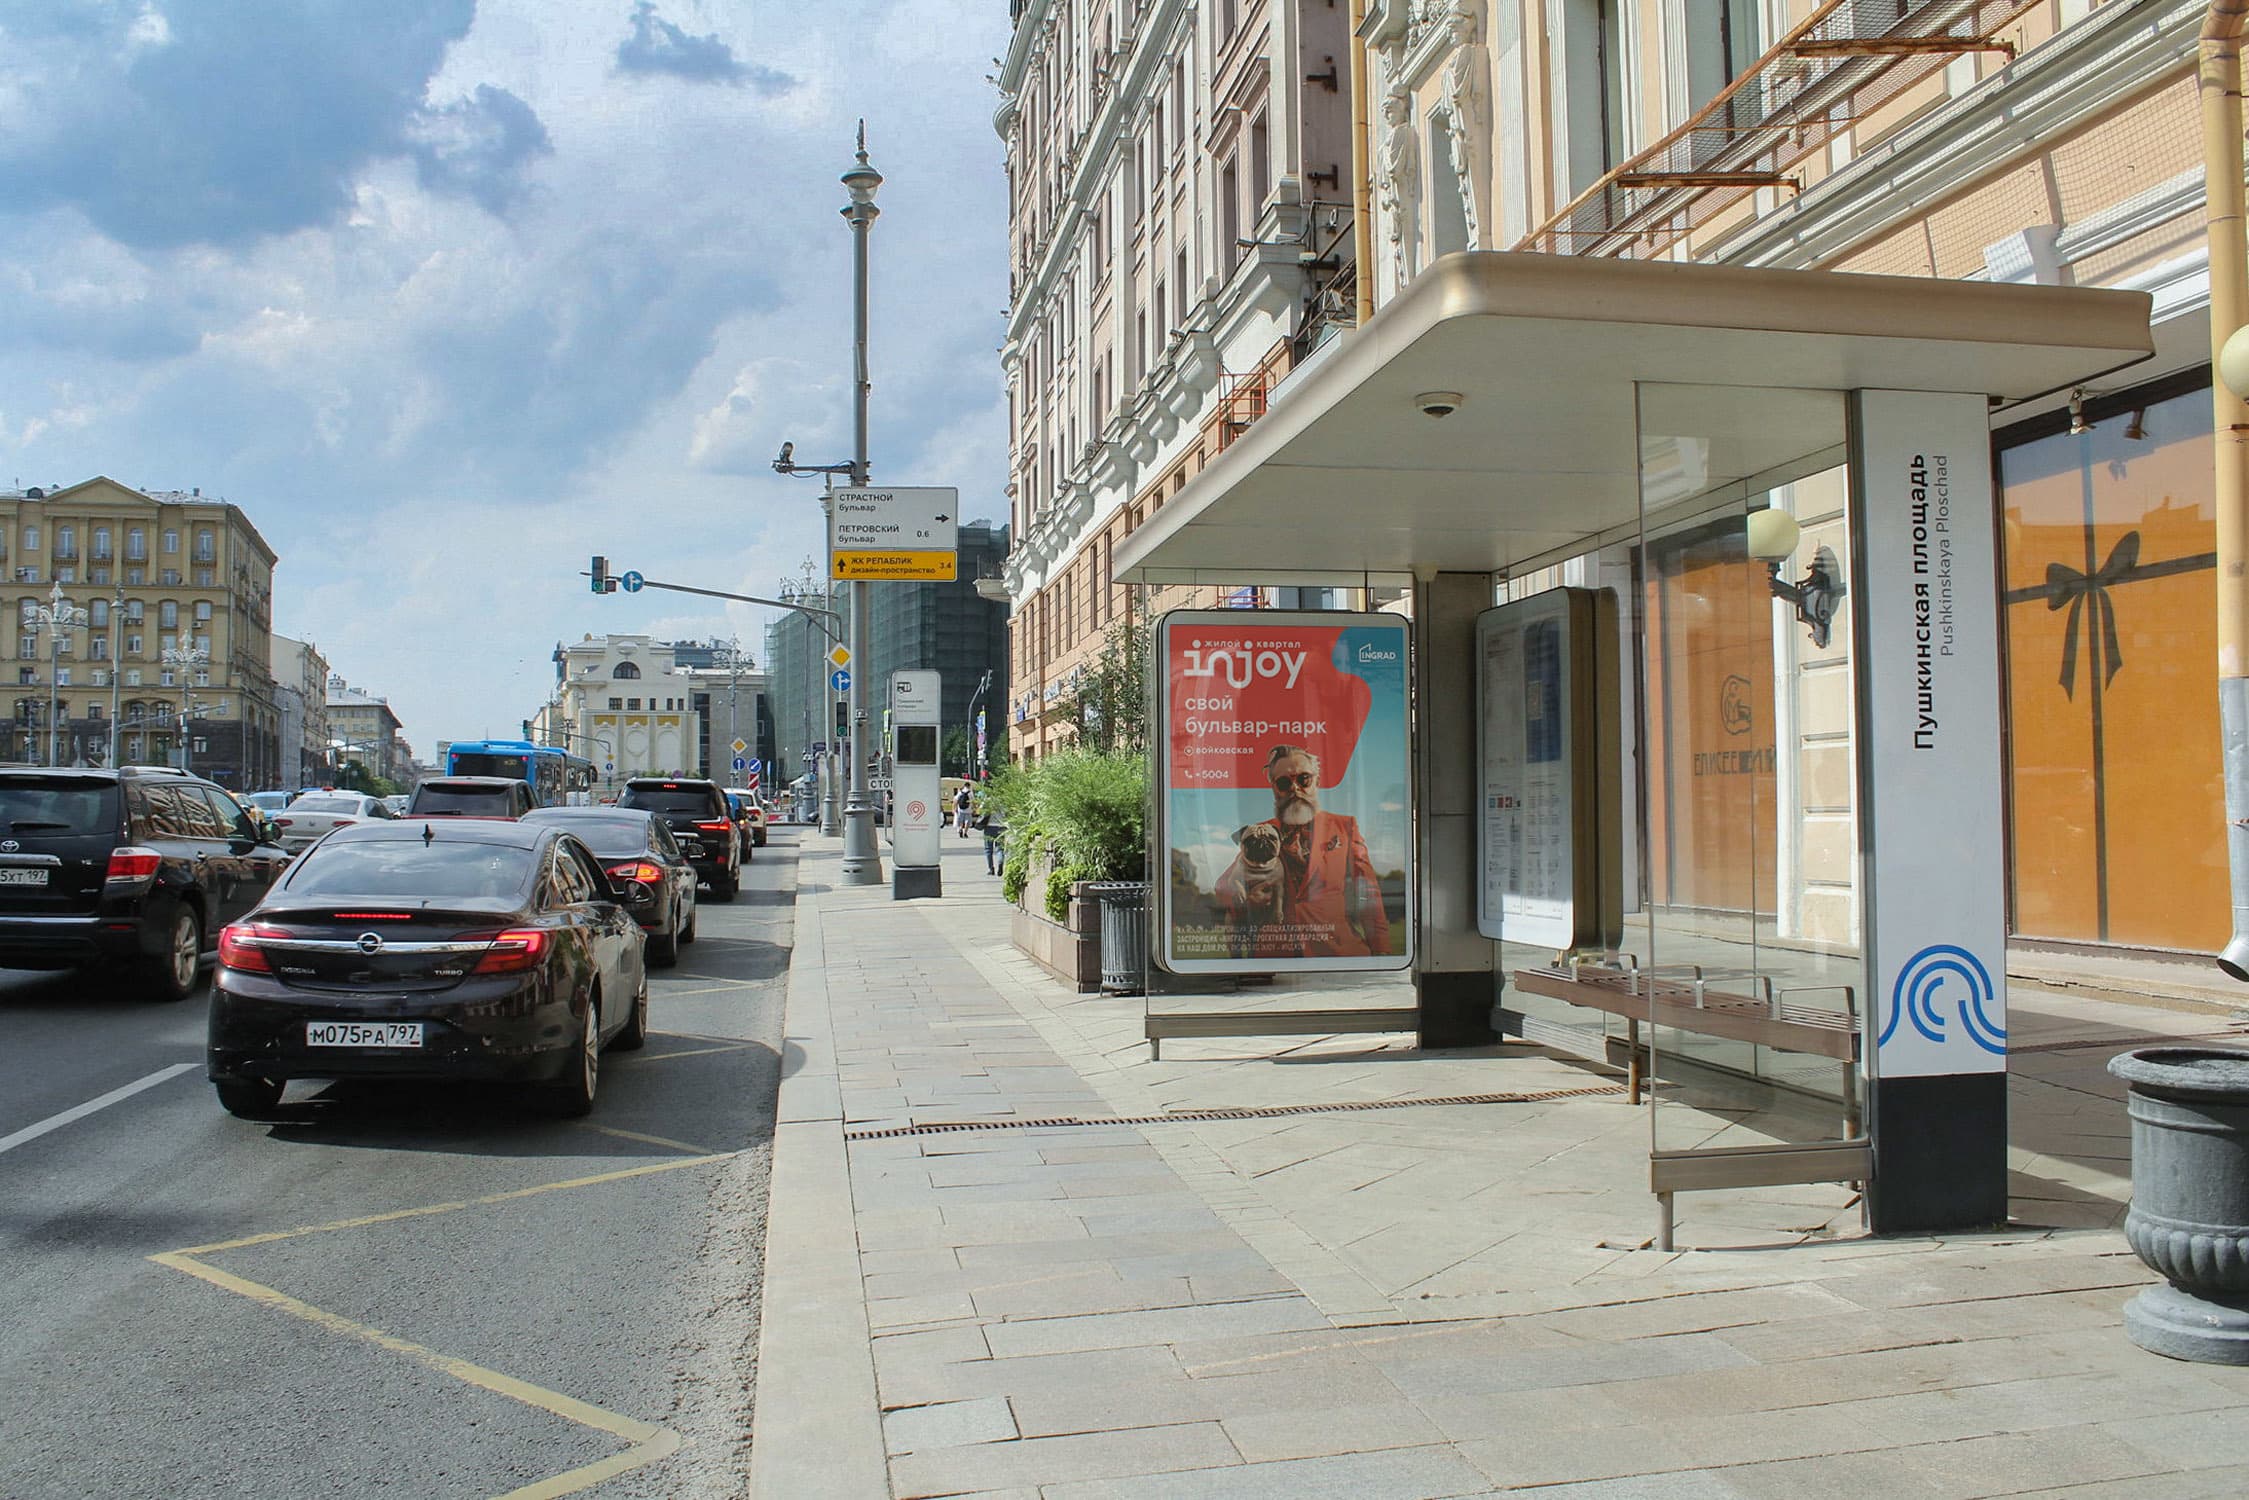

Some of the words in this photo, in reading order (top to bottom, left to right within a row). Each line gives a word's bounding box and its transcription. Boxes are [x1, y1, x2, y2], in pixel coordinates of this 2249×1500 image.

[839, 493, 894, 502] СТРАСТНОЙ
[1933, 455, 1949, 533] Ploschad
[839, 503, 876, 513] бульвар
[1910, 454, 1929, 574] площадь
[838, 524, 900, 533] ПЕТРОВСКИЙ
[916, 530, 930, 538] 0.6
[838, 535, 876, 544] бульвар
[851, 557, 864, 565] ЖК
[865, 557, 913, 565] РЕПАБЛИК
[850, 566, 936, 575] дизайн-пространство
[1937, 539, 1953, 656] Pushkinskaya
[1204, 640, 1240, 649] жилой
[1256, 640, 1301, 650] квартал
[1361, 651, 1397, 660] INGRAD
[1183, 639, 1307, 689] injoy
[1914, 583, 1938, 749] Пушкинская
[1185, 695, 1233, 711] свой
[1185, 716, 1327, 738] бульвар-парк
[1196, 745, 1254, 754] войковская
[870, 780, 893, 789] СТО
[313, 1025, 385, 1044] М075РА
[389, 1025, 417, 1039] 797
